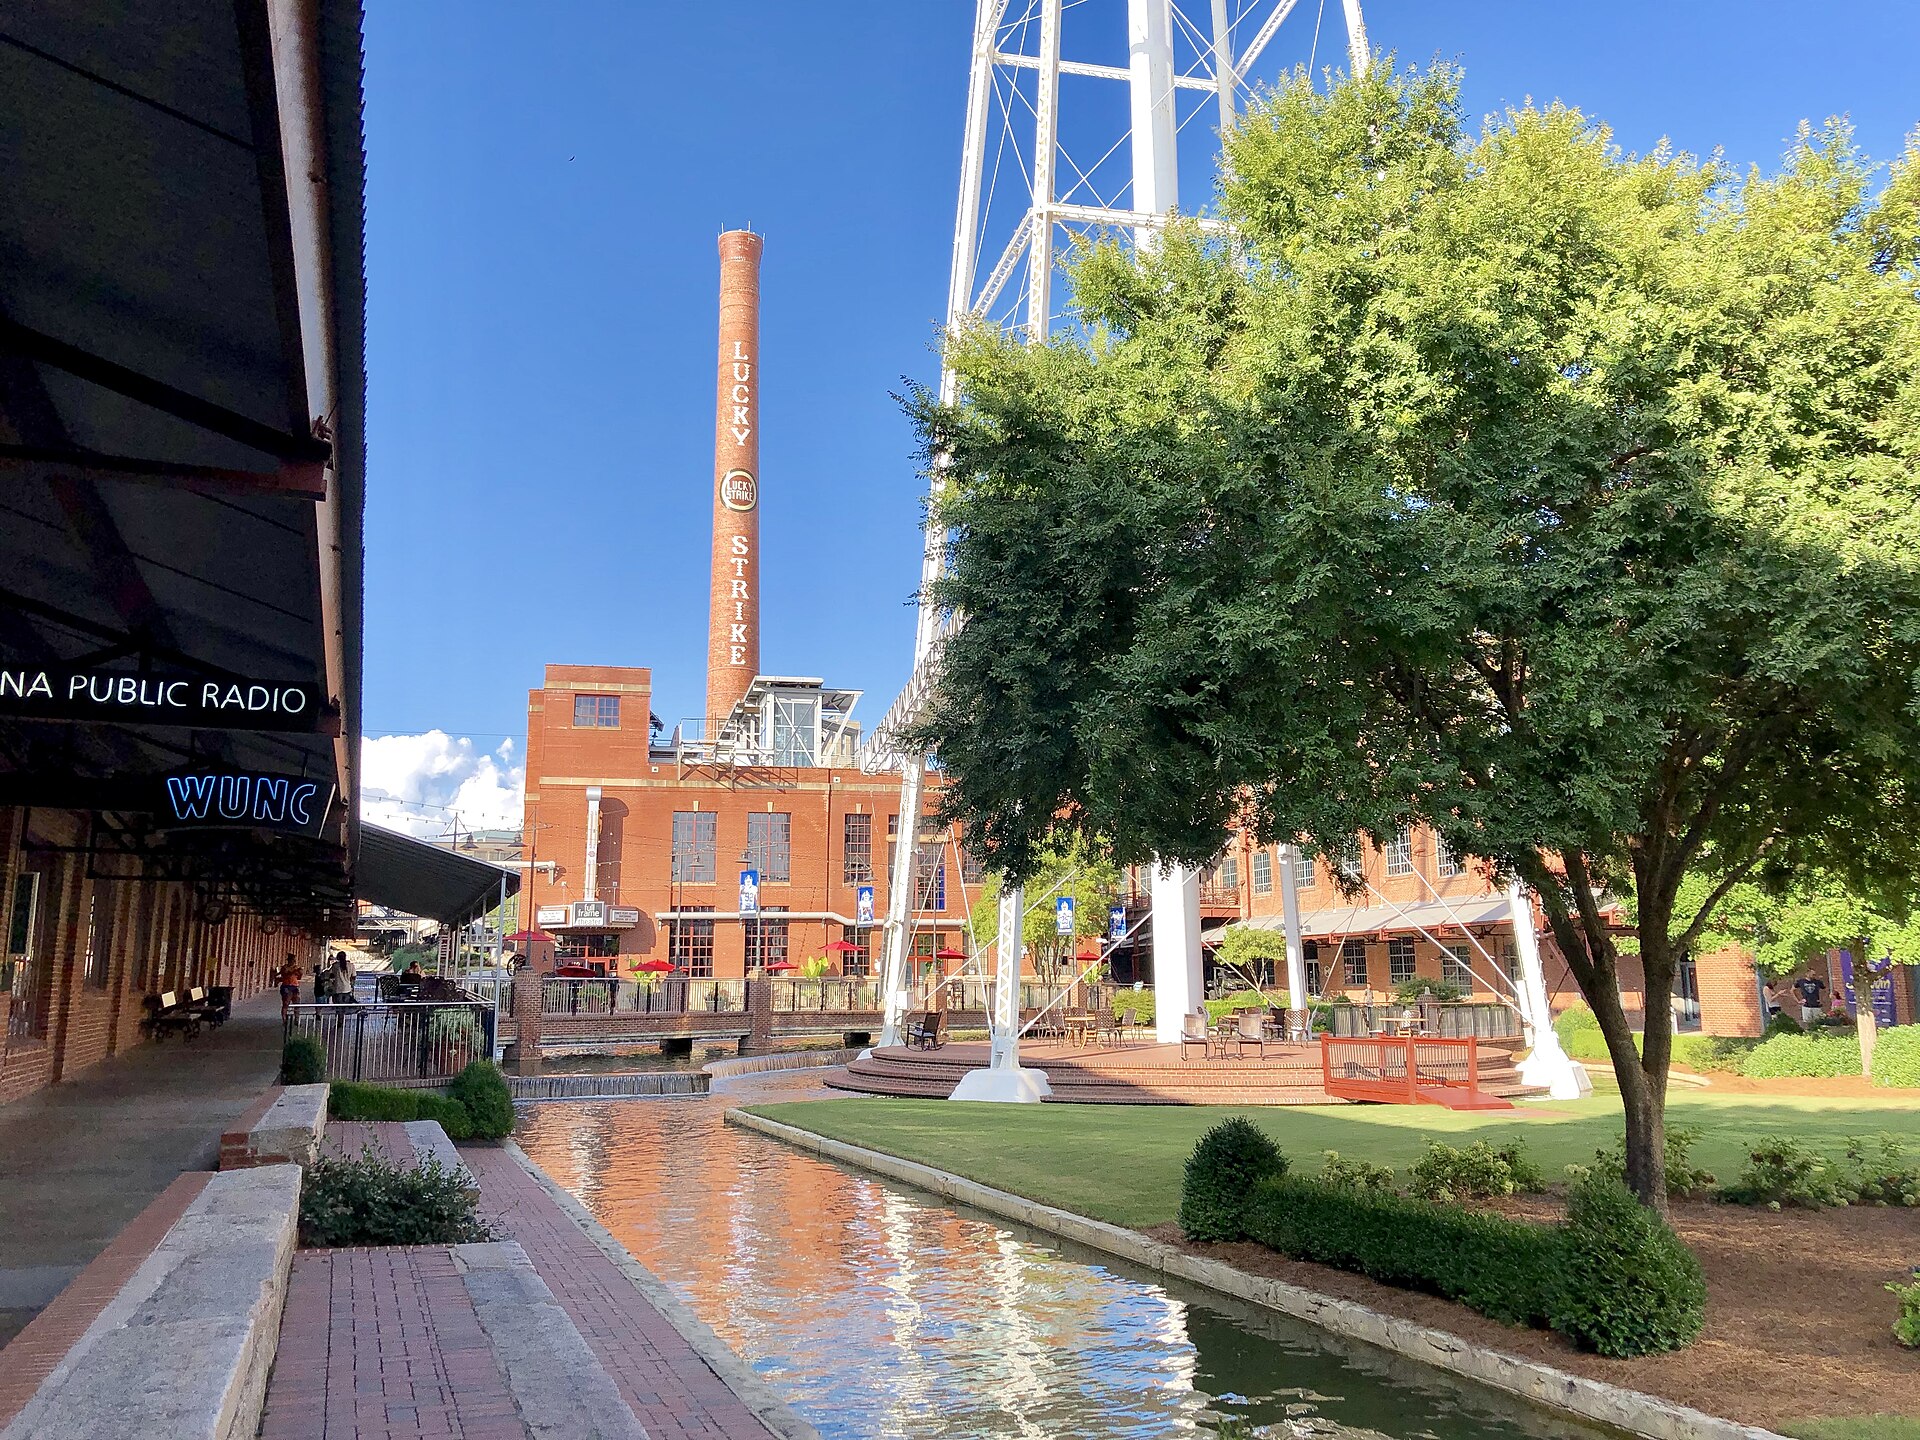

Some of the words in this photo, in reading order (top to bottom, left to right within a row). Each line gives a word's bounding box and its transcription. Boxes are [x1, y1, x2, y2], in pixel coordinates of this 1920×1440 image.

[731, 341, 751, 446] LUCKY
[726, 490, 753, 502] STRIKE
[727, 480, 753, 492] LUCKY
[730, 535, 749, 665] STRIKE
[69, 675, 189, 707] PUBLIC
[202, 683, 306, 713] RADIO
[167, 775, 317, 825] WUNC
[578, 908, 600, 917] frame
[584, 903, 596, 912] full
